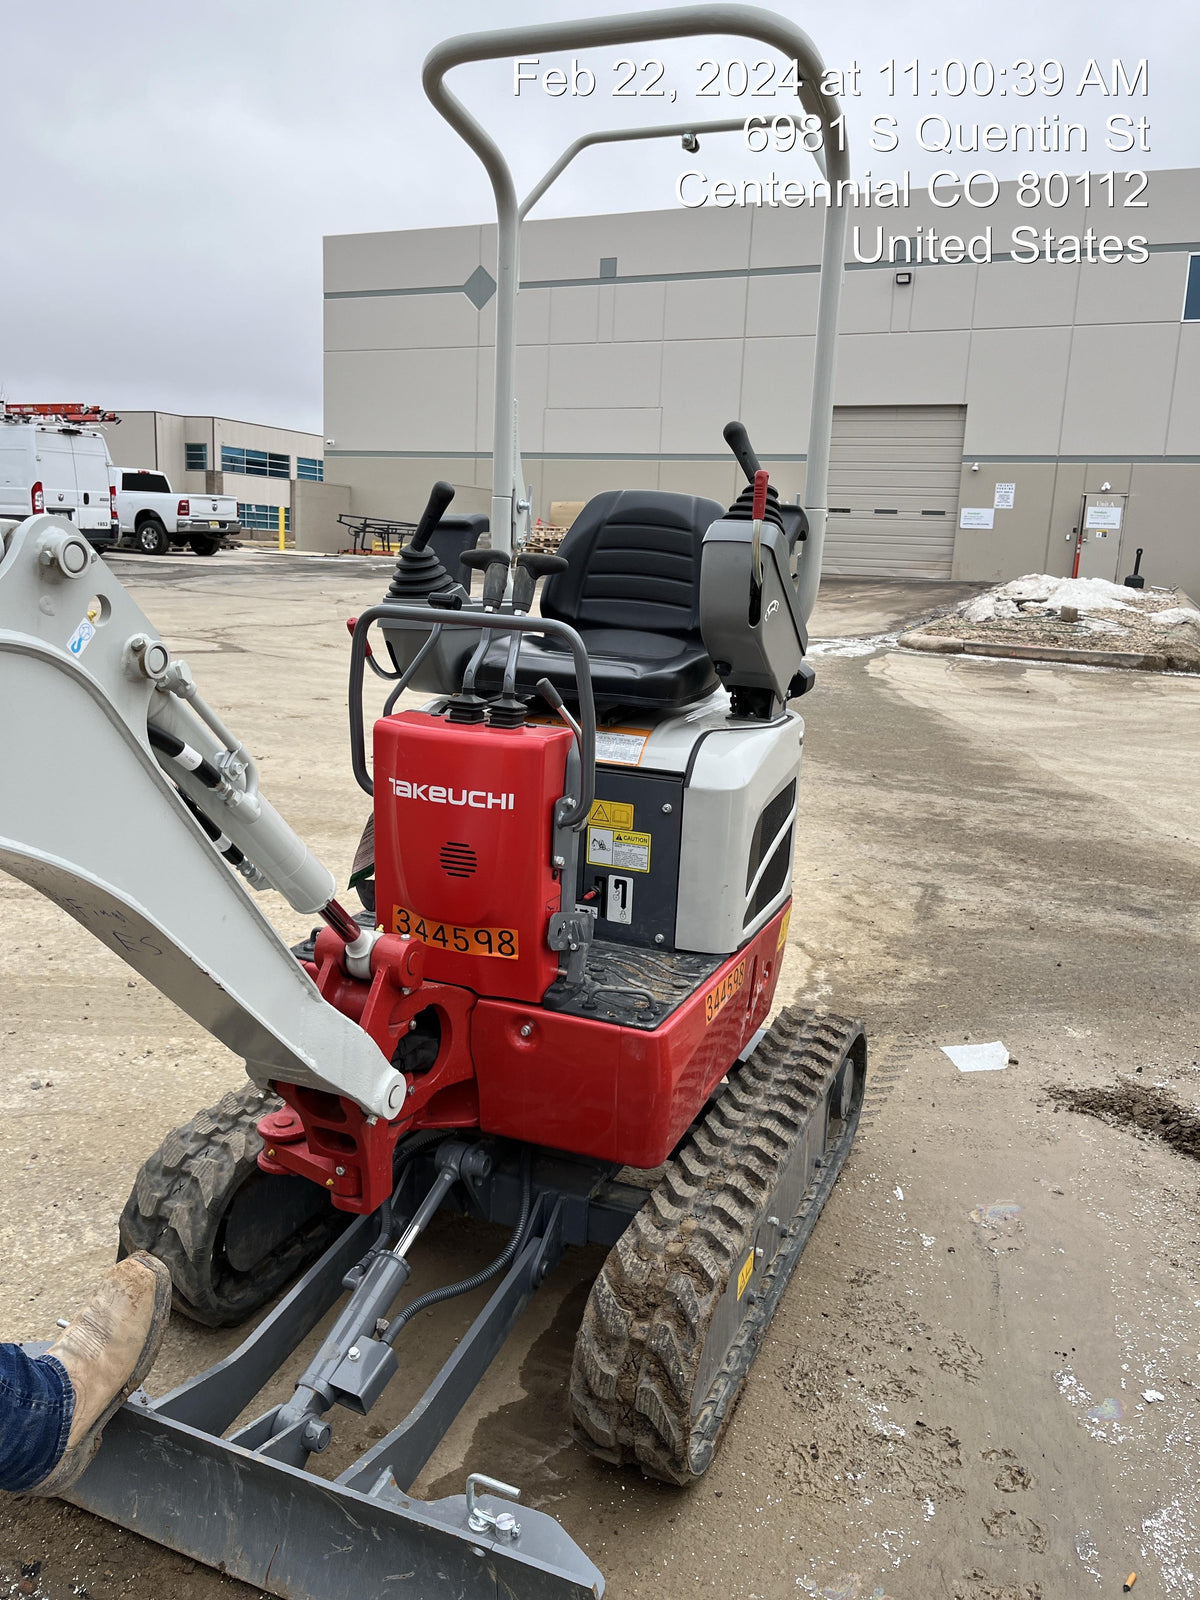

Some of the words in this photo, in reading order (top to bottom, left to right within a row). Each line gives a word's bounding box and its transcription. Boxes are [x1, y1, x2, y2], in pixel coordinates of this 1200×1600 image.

[388, 777, 515, 810] TAKEUCHI
[623, 834, 648, 844] CAUTION
[396, 908, 516, 957] 344598
[706, 962, 745, 1022] 344598
